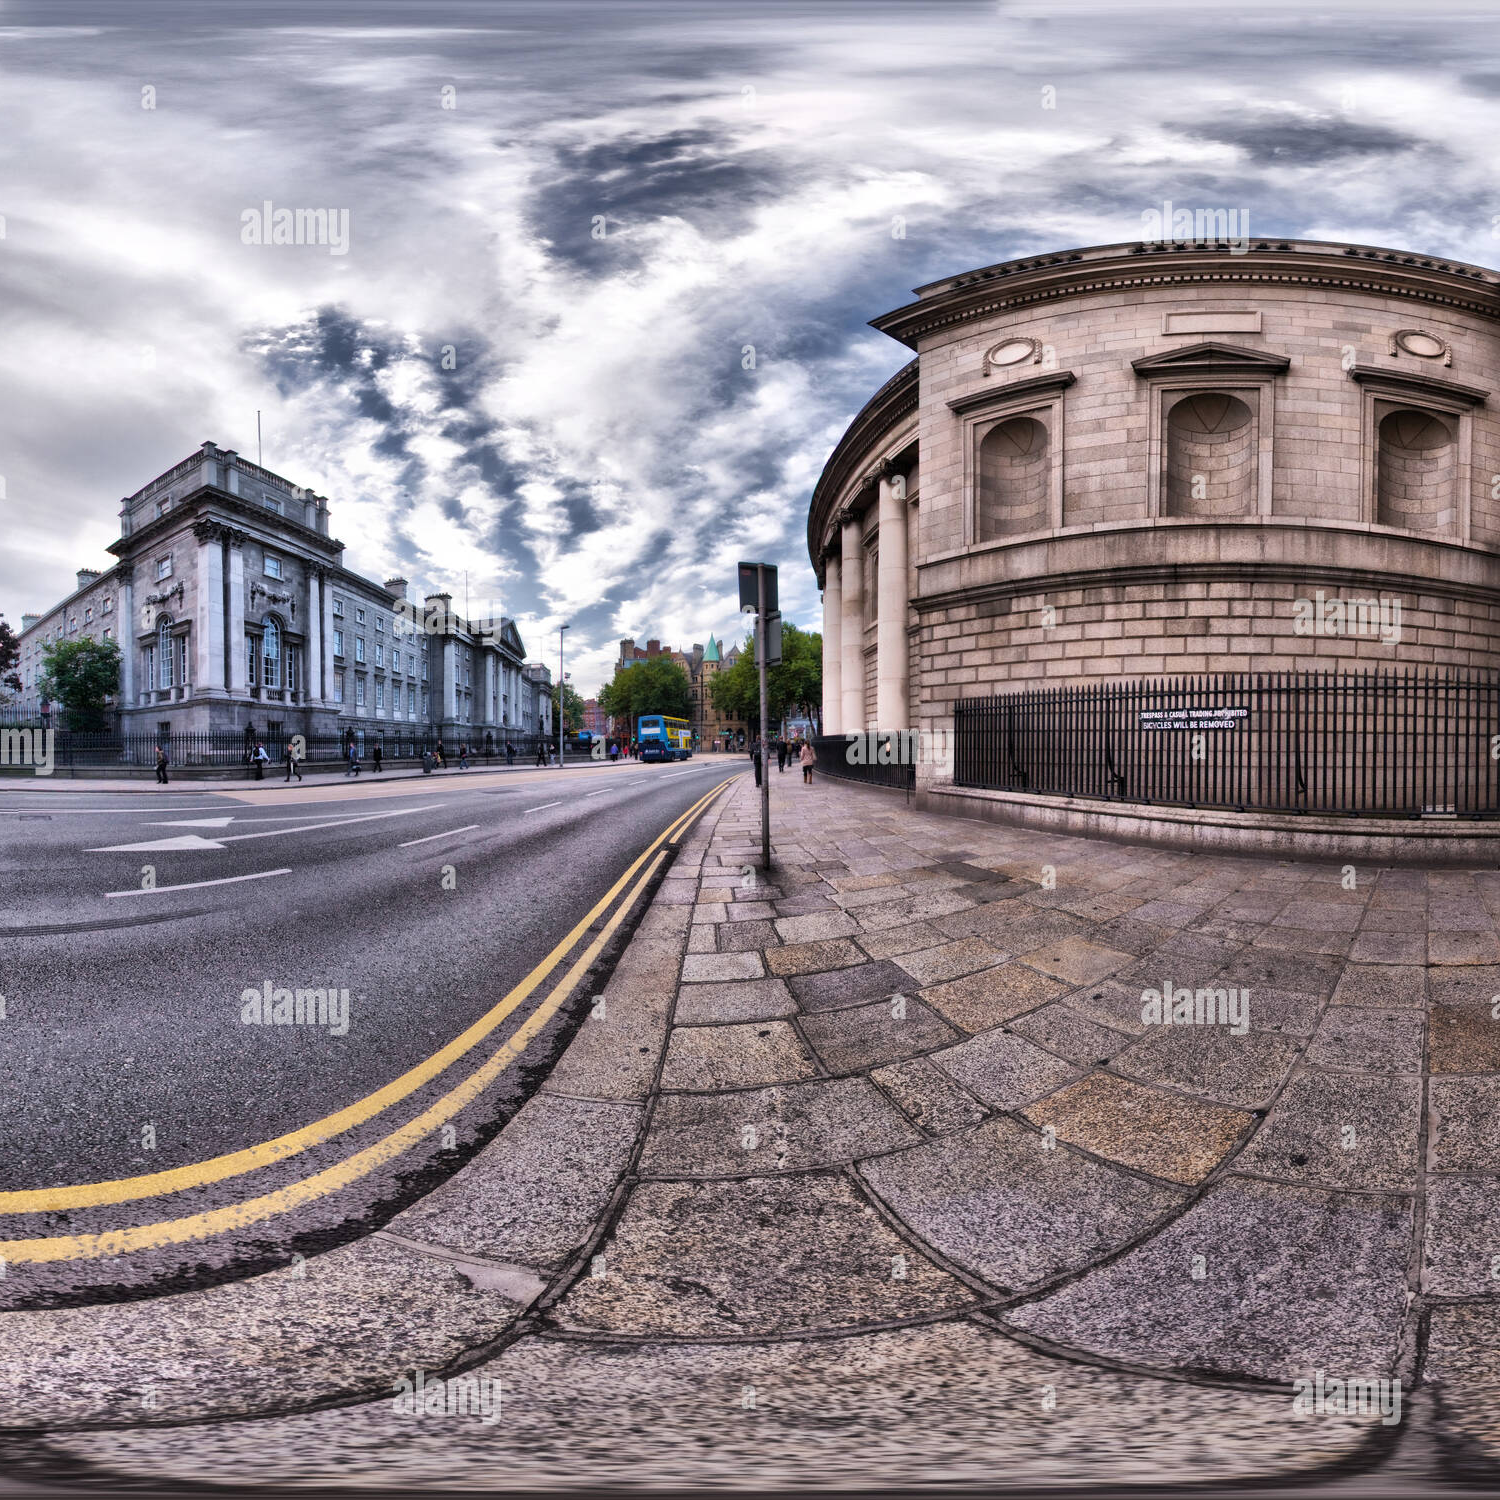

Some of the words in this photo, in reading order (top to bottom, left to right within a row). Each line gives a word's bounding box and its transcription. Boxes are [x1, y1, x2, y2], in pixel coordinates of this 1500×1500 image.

[1169, 710, 1188, 719] CASUAL
[1189, 710, 1212, 718] TRADING
[1143, 721, 1171, 729] BICYCLES
[1173, 721, 1189, 729] WILL
[1190, 721, 1198, 729] BE
[1199, 720, 1235, 728] REMOVED
